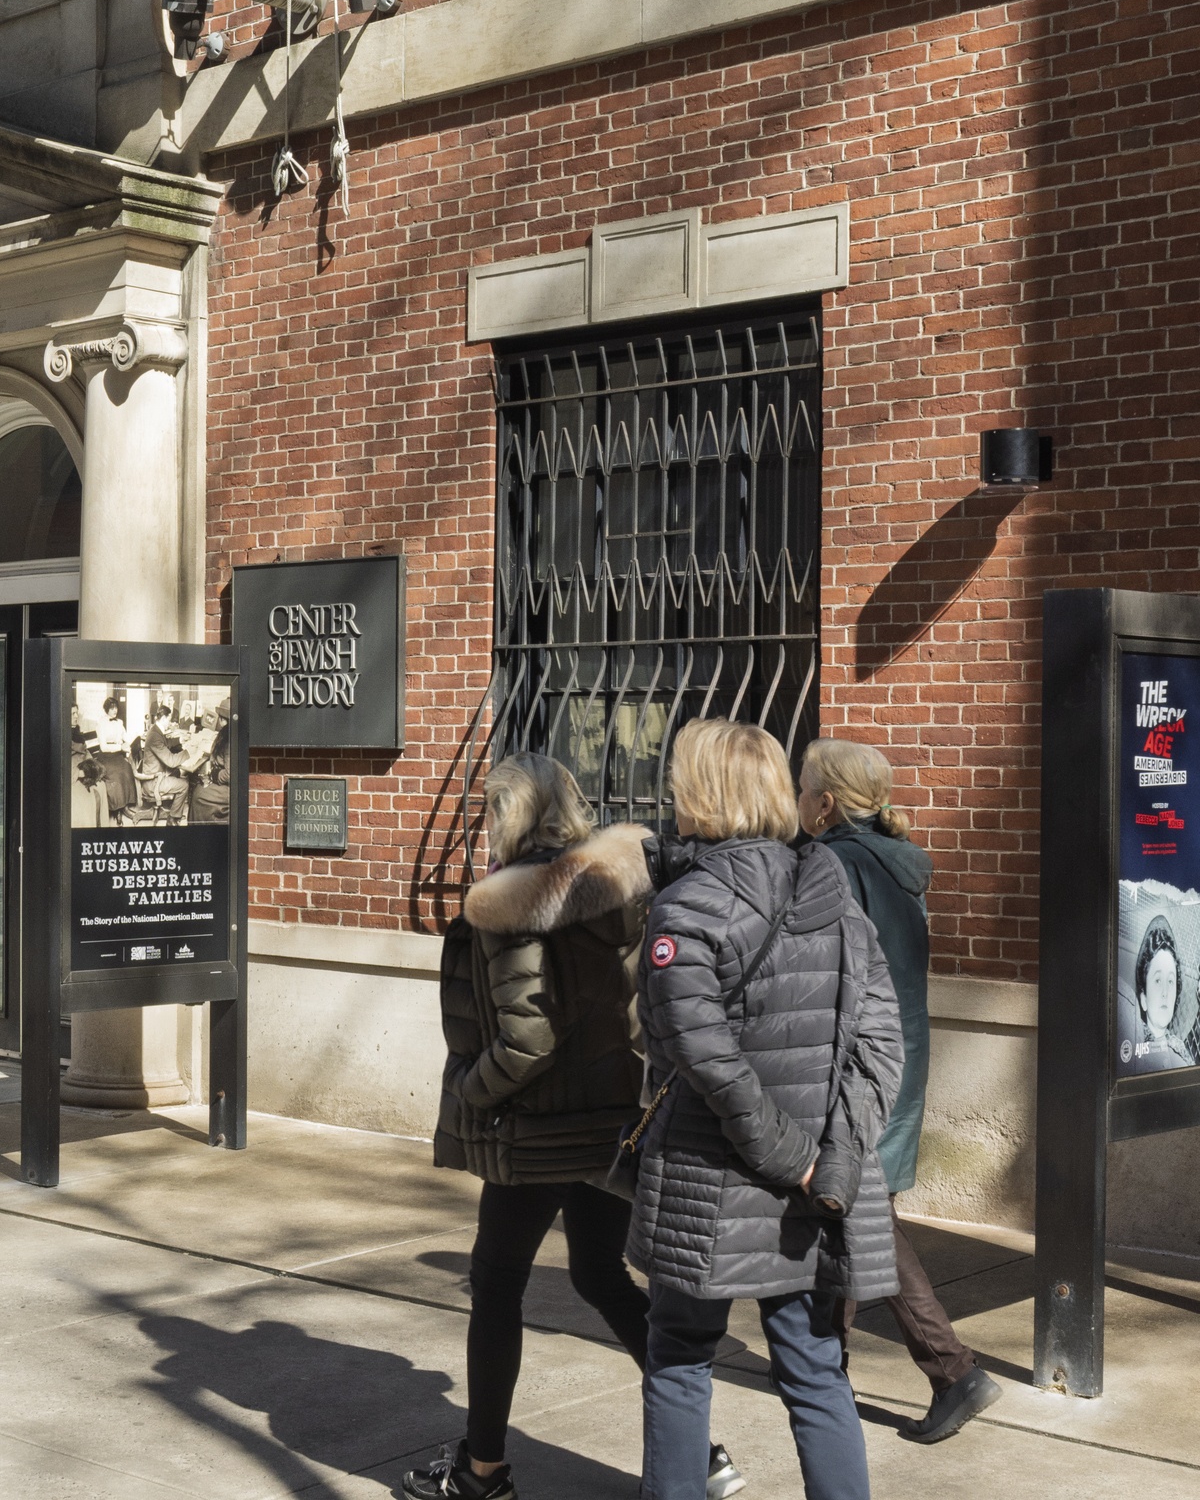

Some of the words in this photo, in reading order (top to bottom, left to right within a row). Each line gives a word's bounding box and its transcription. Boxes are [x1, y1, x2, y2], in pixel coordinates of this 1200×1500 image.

[269, 603, 363, 636] CENTER
[269, 637, 282, 672] FOR
[280, 637, 356, 673] JEWISH
[268, 673, 360, 707] HISTORY
[1140, 680, 1168, 704] THE
[1136, 704, 1187, 732] WRECK
[1143, 730, 1174, 758] AGE
[1136, 757, 1172, 771] AMERICAN
[1141, 772, 1186, 785] SUBVERSIVES
[294, 789, 340, 802] BRUCE
[294, 804, 340, 816] SLOVIN
[294, 823, 340, 833] FOUNDER
[81, 841, 164, 855] RUNAWAY
[81, 857, 181, 873] HUSBANDS,
[112, 873, 212, 889] DESPERATE
[128, 889, 212, 905] FAMILIES
[80, 917, 93, 925] The
[94, 916, 112, 926] Story
[113, 915, 120, 924] of
[120, 915, 132, 924] the
[132, 914, 159, 923] National
[160, 912, 190, 922] Desertion
[191, 912, 214, 920] Bureau
[1135, 1042, 1150, 1058] AJHS
